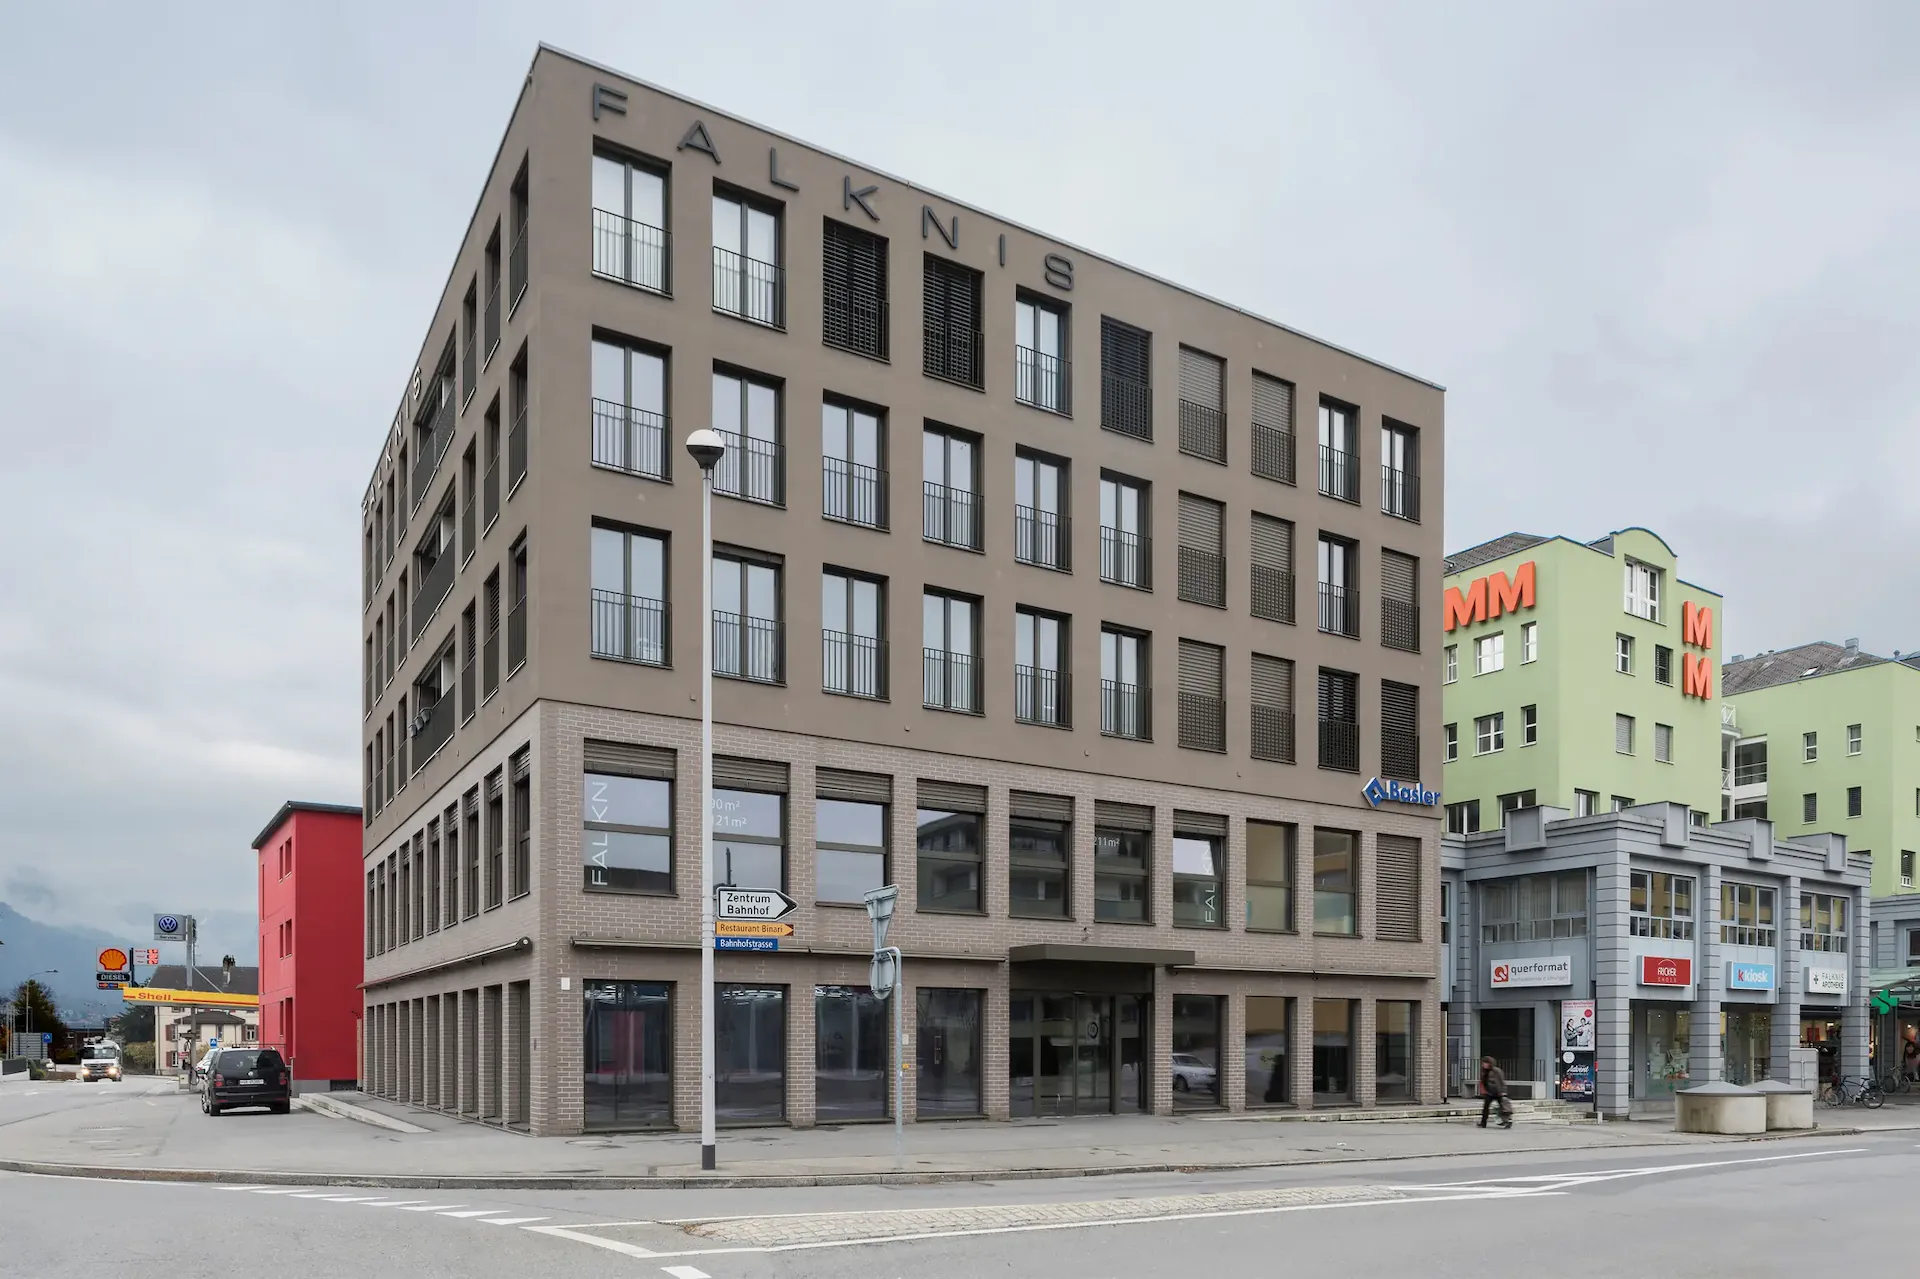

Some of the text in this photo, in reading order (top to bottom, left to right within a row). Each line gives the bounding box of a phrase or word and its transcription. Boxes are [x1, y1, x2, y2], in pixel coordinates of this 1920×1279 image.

[592, 82, 1075, 292] FALKNIS
[1444, 561, 1536, 633] MM
[1386, 780, 1441, 806] Basler
[592, 781, 608, 886] FALKN
[727, 893, 771, 904] Zentrum
[727, 905, 770, 915] Bahnhof
[720, 923, 783, 933] Restaurant Binari
[720, 939, 773, 949] Bahnhofstrasse
[1511, 961, 1568, 976] querformat
[1821, 973, 1844, 982] FALKNIS
[1821, 981, 1844, 989] APOTHEKE
[138, 992, 171, 1001] Shell
